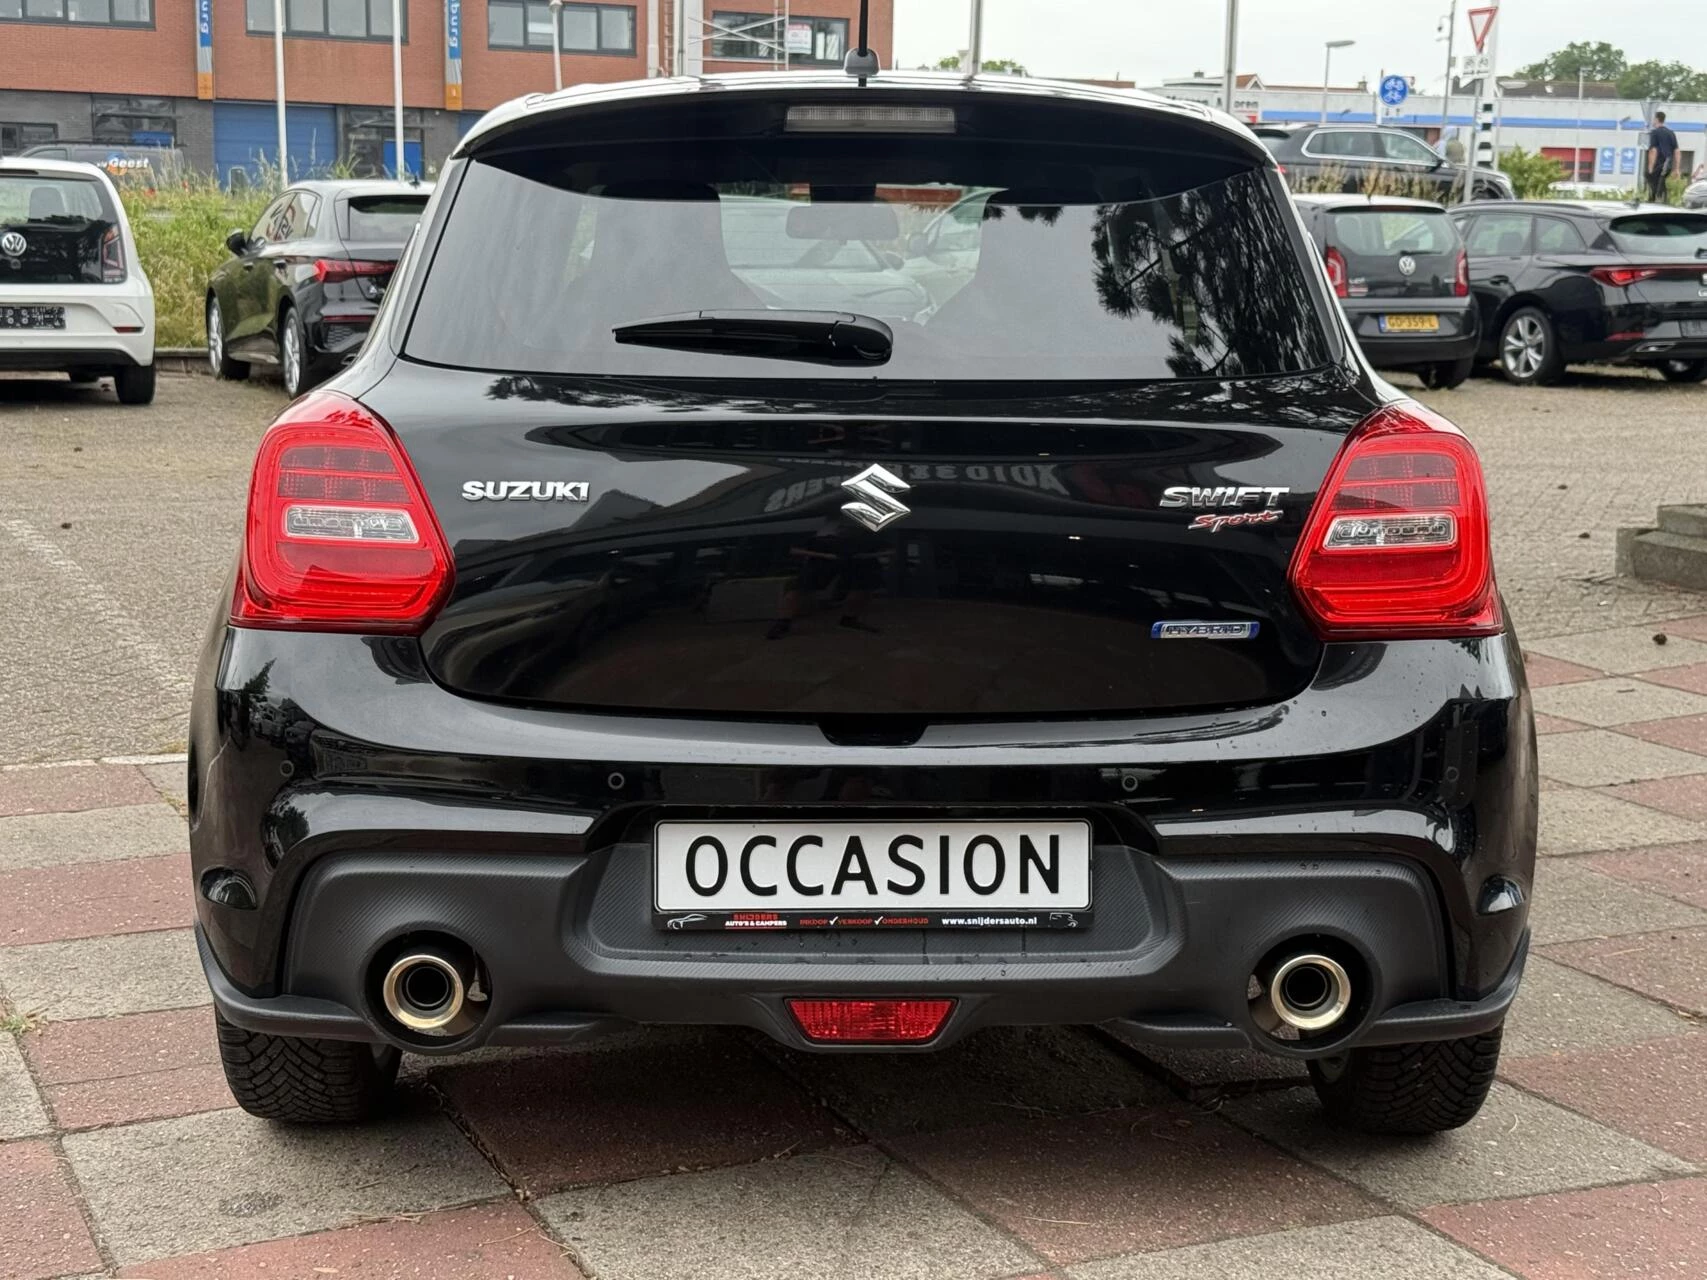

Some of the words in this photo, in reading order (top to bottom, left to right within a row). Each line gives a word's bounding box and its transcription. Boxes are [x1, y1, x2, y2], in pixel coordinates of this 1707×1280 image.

[461, 480, 590, 502] SUZUKI
[1159, 486, 1290, 508] SWIFT
[1187, 510, 1284, 533] Sport
[1167, 624, 1244, 636] HYBRID
[685, 834, 1060, 897] OCCASION
[941, 916, 1037, 926] www.snijdersauto.nl
